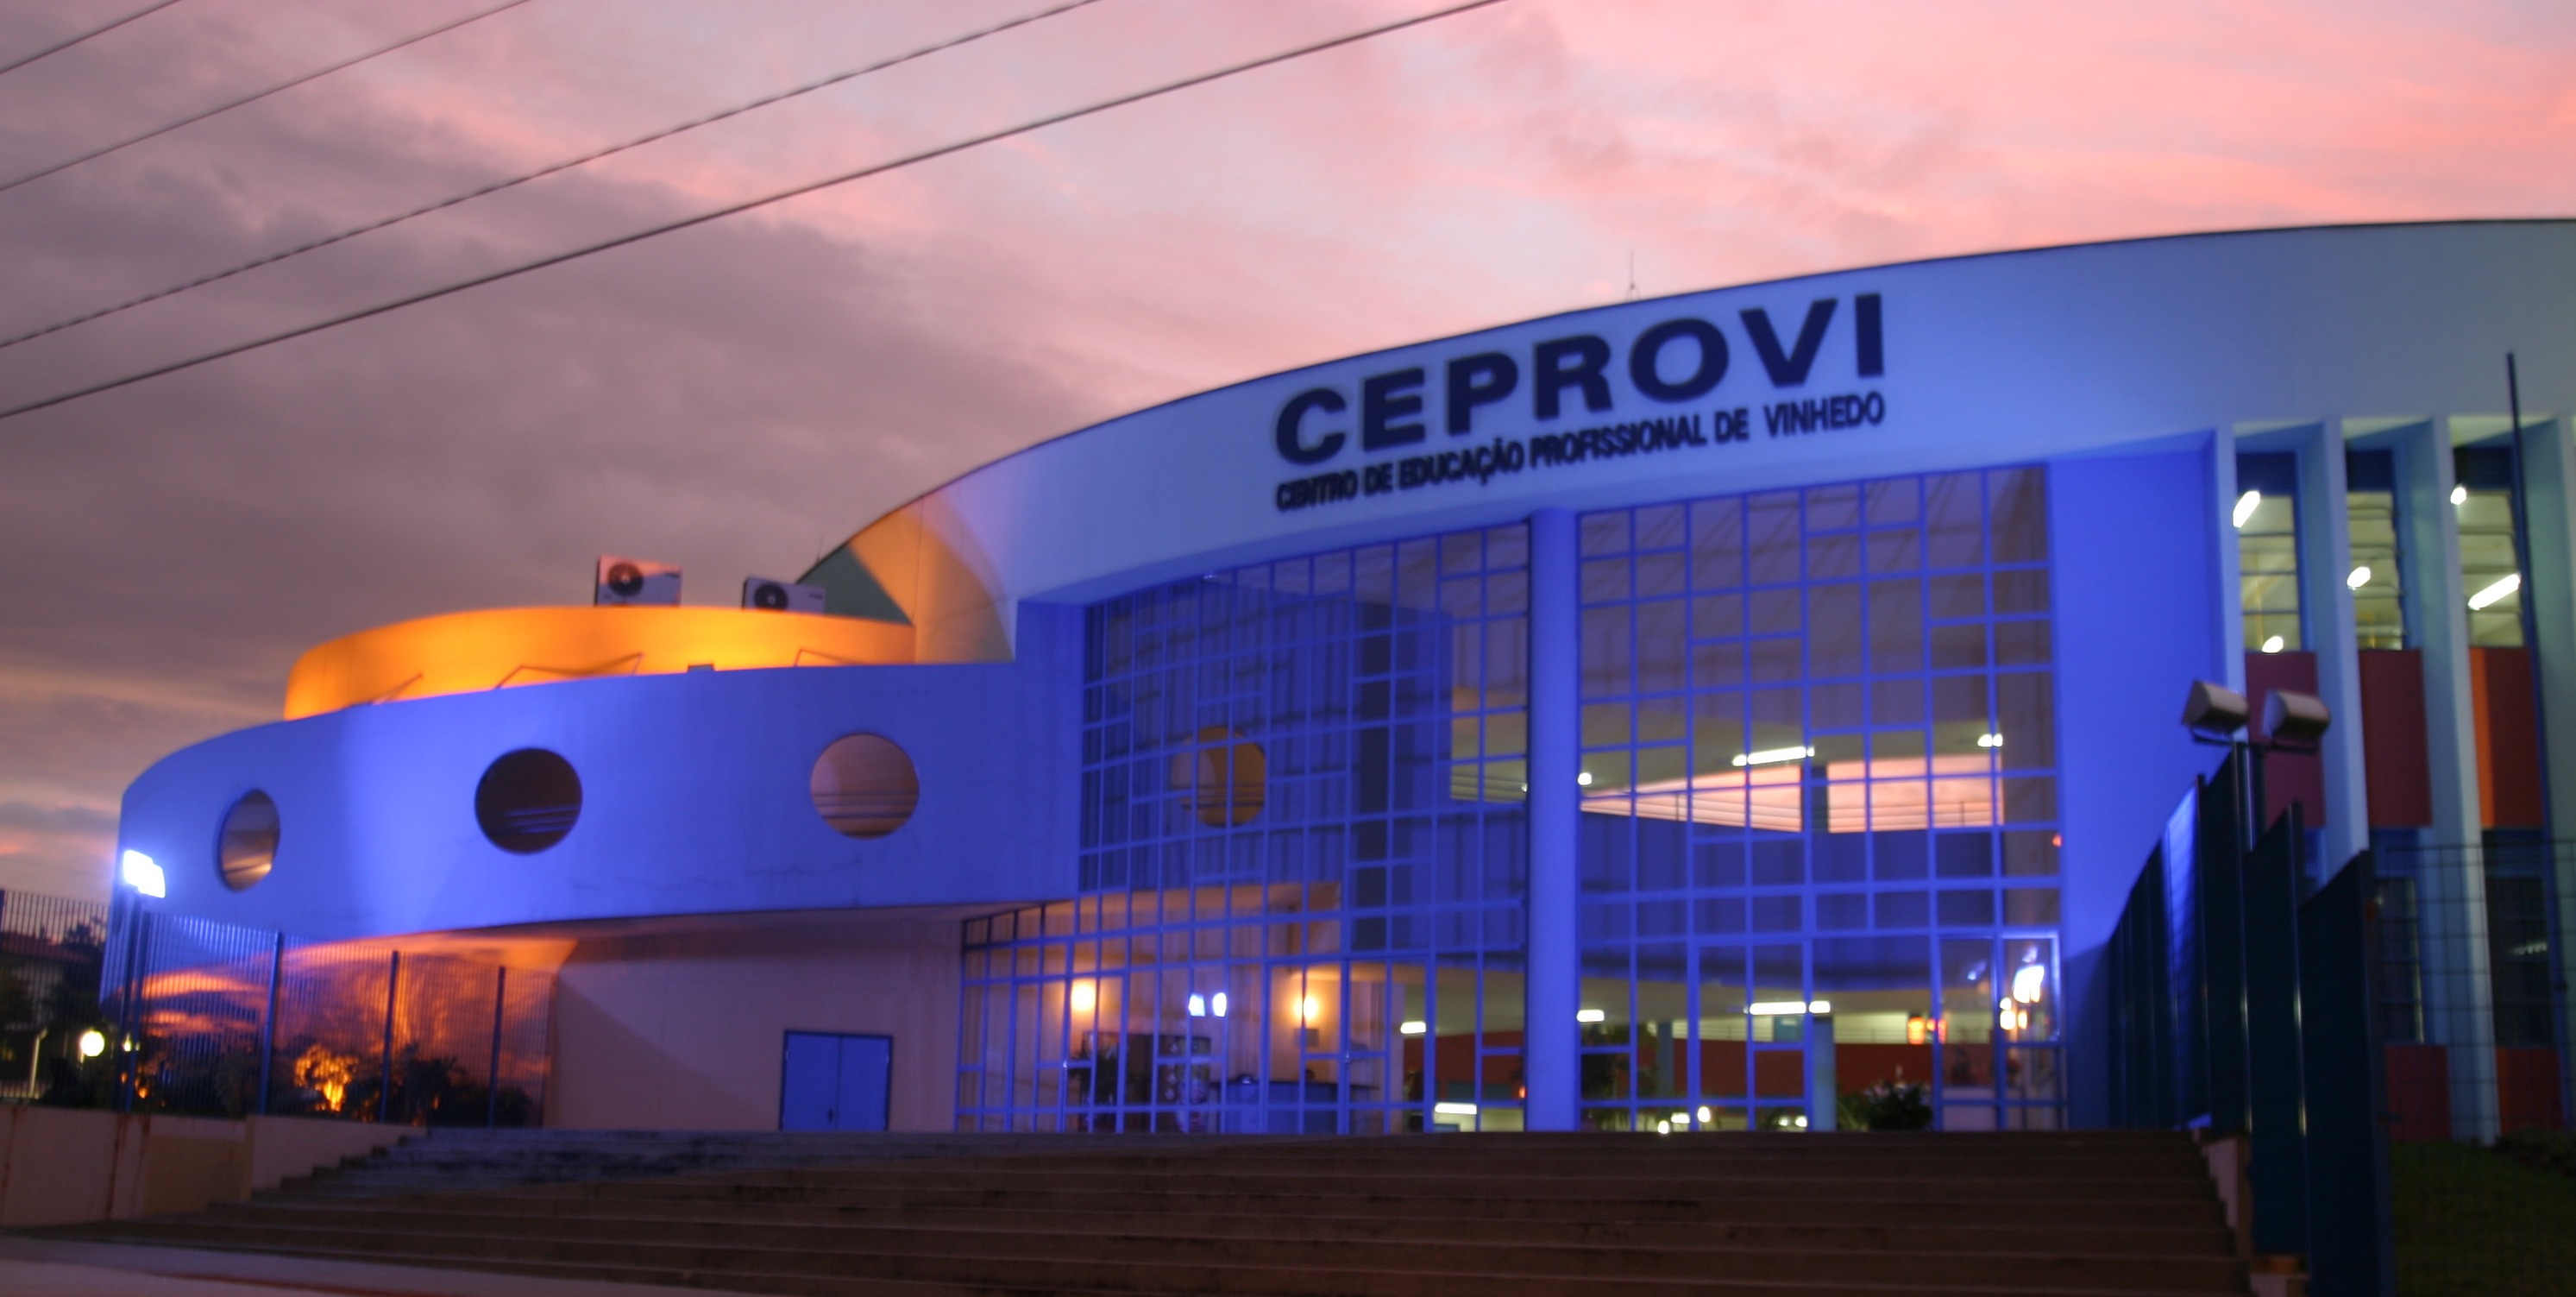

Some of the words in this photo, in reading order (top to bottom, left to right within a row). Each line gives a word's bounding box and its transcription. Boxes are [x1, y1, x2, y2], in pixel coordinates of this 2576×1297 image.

[1275, 293, 1885, 464] CEPROVI
[1277, 469, 1358, 512] CENTRO
[1365, 463, 1393, 495] DE
[1398, 438, 1524, 486] EDUCAÇÃO
[1530, 414, 1706, 467] PROFISSIONAL
[1714, 407, 1749, 443] DE
[1763, 391, 1885, 438] VINHEDO
